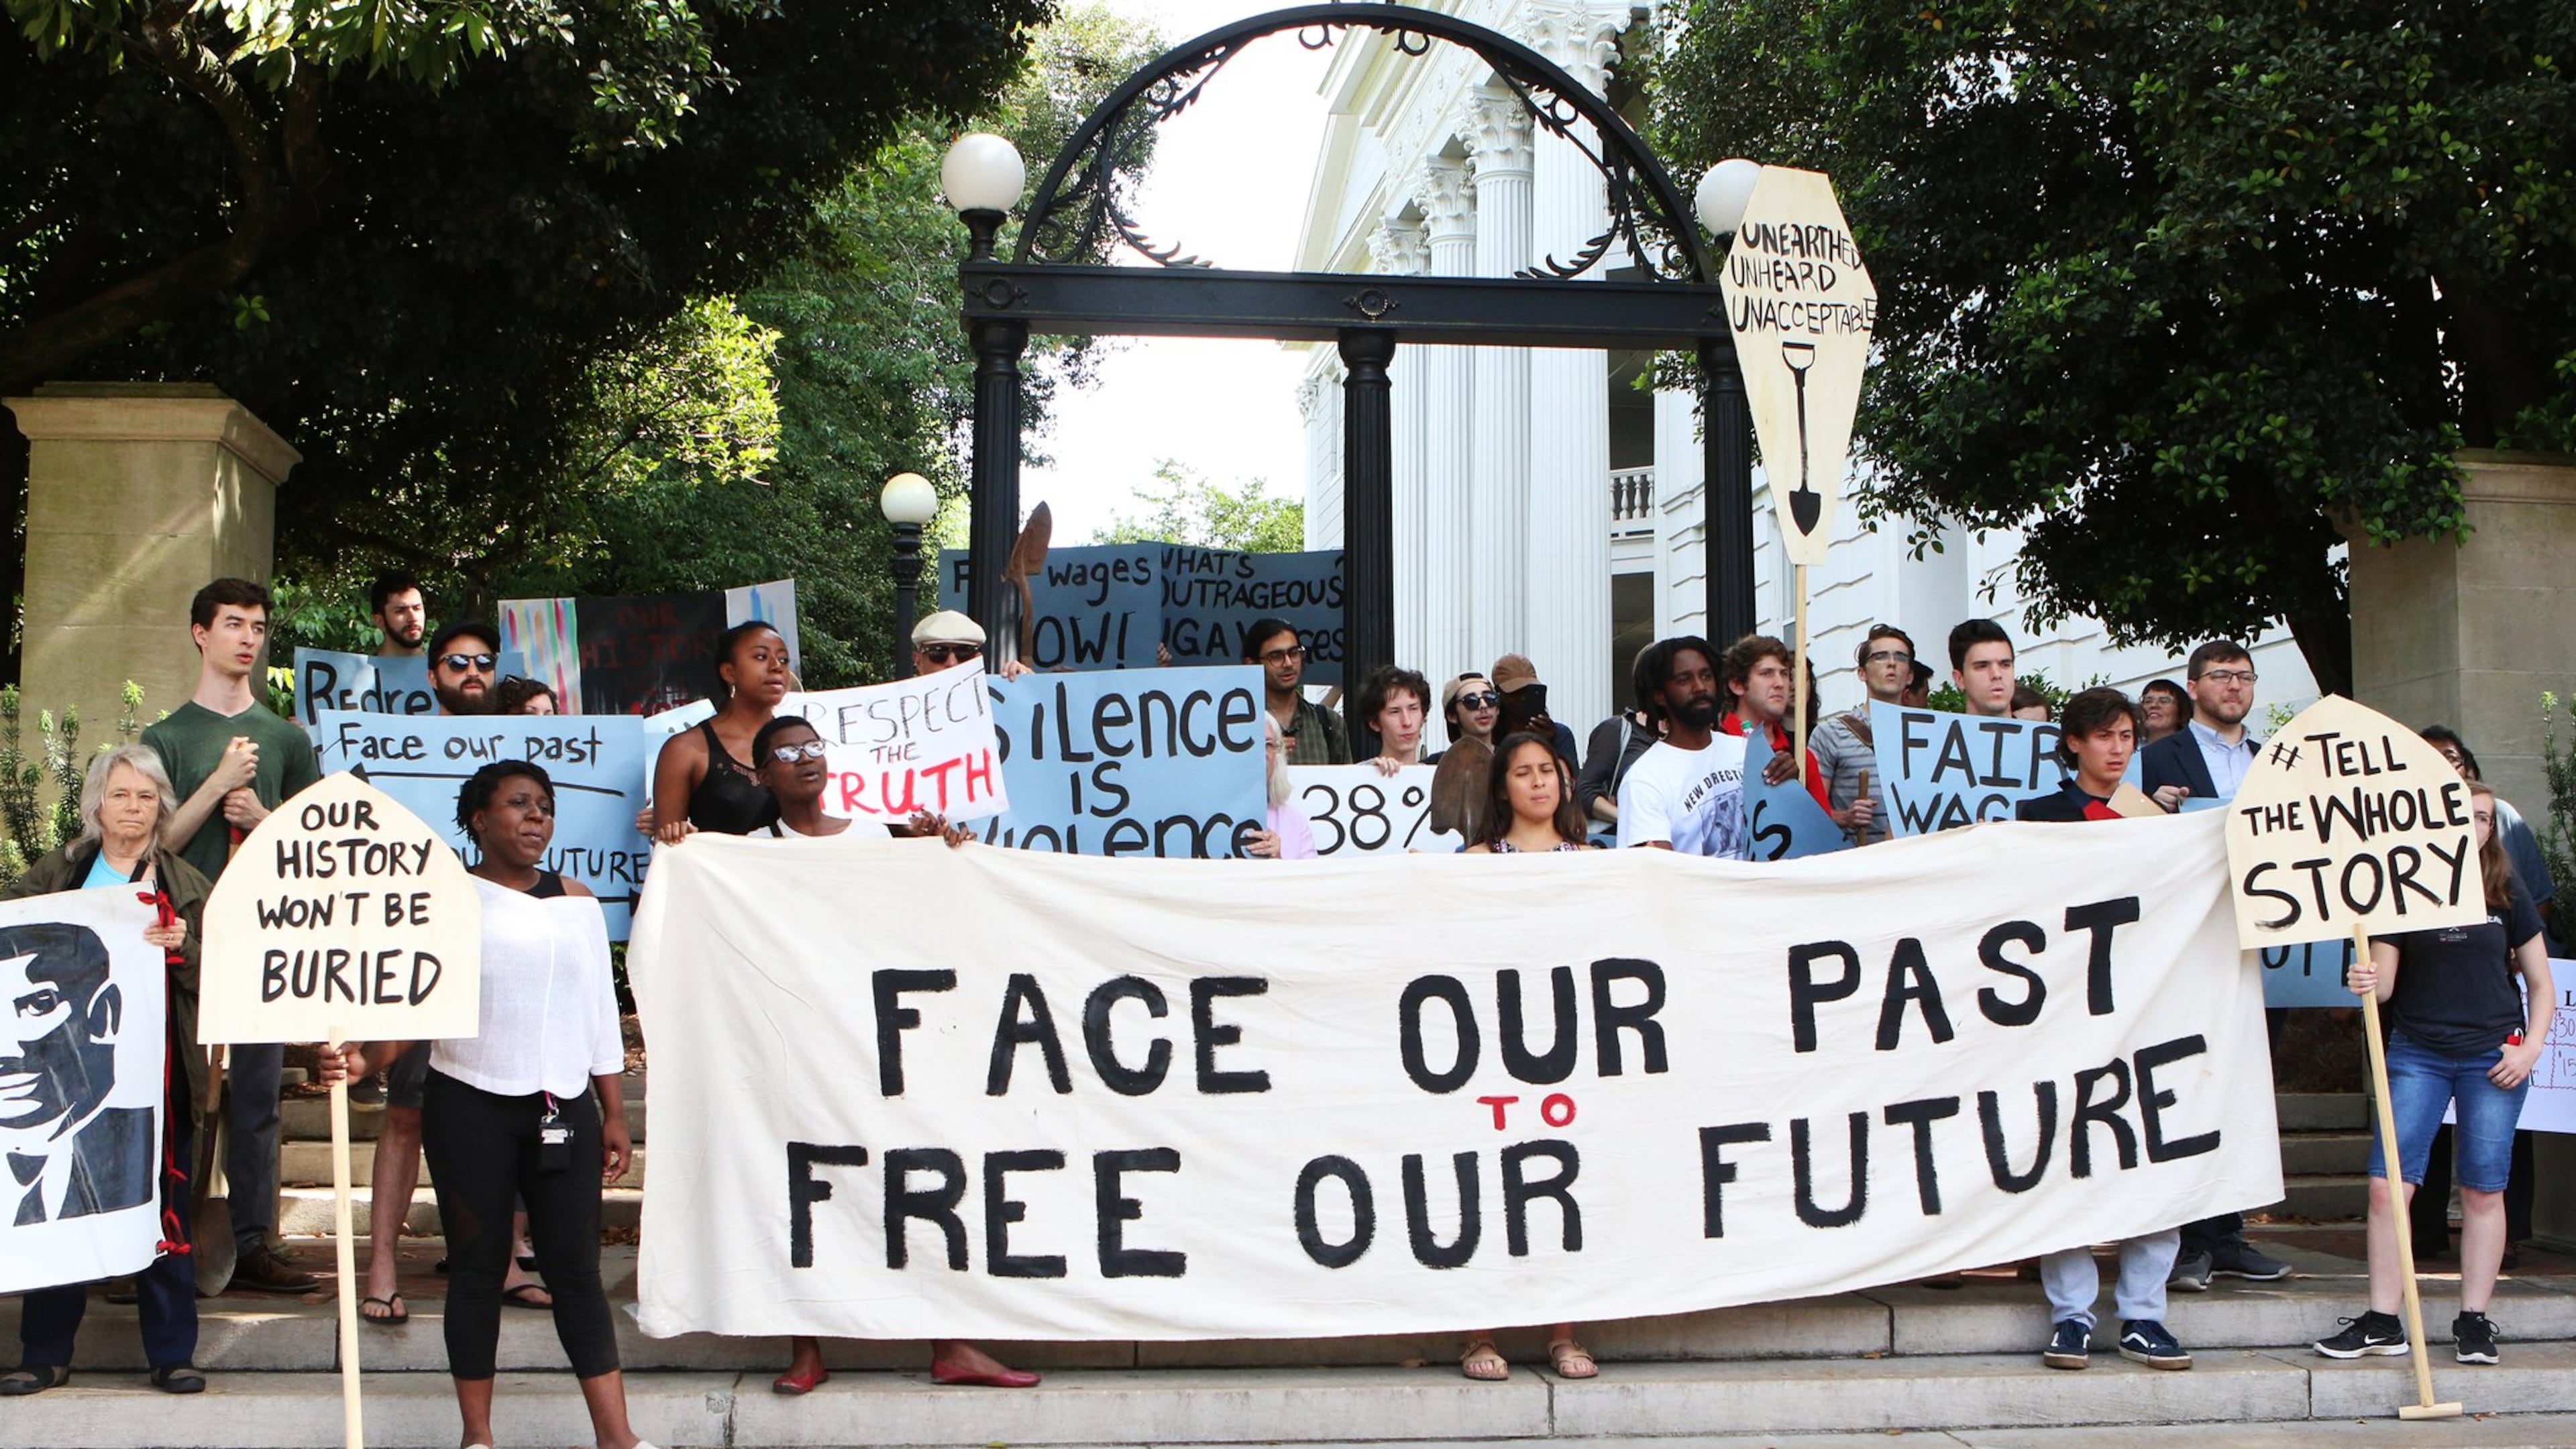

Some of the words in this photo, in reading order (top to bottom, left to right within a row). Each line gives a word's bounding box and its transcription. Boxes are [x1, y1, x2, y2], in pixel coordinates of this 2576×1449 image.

[1741, 221, 1863, 271] UNEARTHED
[1731, 254, 1837, 293] UNHEARD
[1733, 294, 1878, 335] UNACCEPTABLE
[1047, 556, 1152, 607] wages
[1018, 610, 1136, 669] OW!
[339, 722, 428, 761] Face
[443, 734, 505, 761] our
[525, 725, 604, 769] past
[870, 741, 922, 765] THE
[1900, 712, 2070, 791] FAIR
[301, 800, 380, 831] OUR
[1684, 784, 1704, 813] NEW
[1890, 781, 2023, 835] WAG
[2240, 800, 2304, 837] THE
[2309, 782, 2471, 844] WHOLE
[276, 838, 433, 879] HISTORY
[533, 847, 650, 884] UTURE
[2242, 835, 2469, 932] STORY
[256, 892, 370, 930] WON'T
[384, 892, 432, 928] BE
[261, 949, 443, 1007] BURIED
[871, 968, 1273, 1097] FACE
[1398, 957, 1670, 1095] OUR
[1787, 896, 2141, 1053] PAST
[1477, 1092, 1578, 1131] TO
[786, 1140, 1187, 1279] FREE
[1293, 1138, 1583, 1271] OUR
[1697, 1033, 2222, 1240] FUTURE
